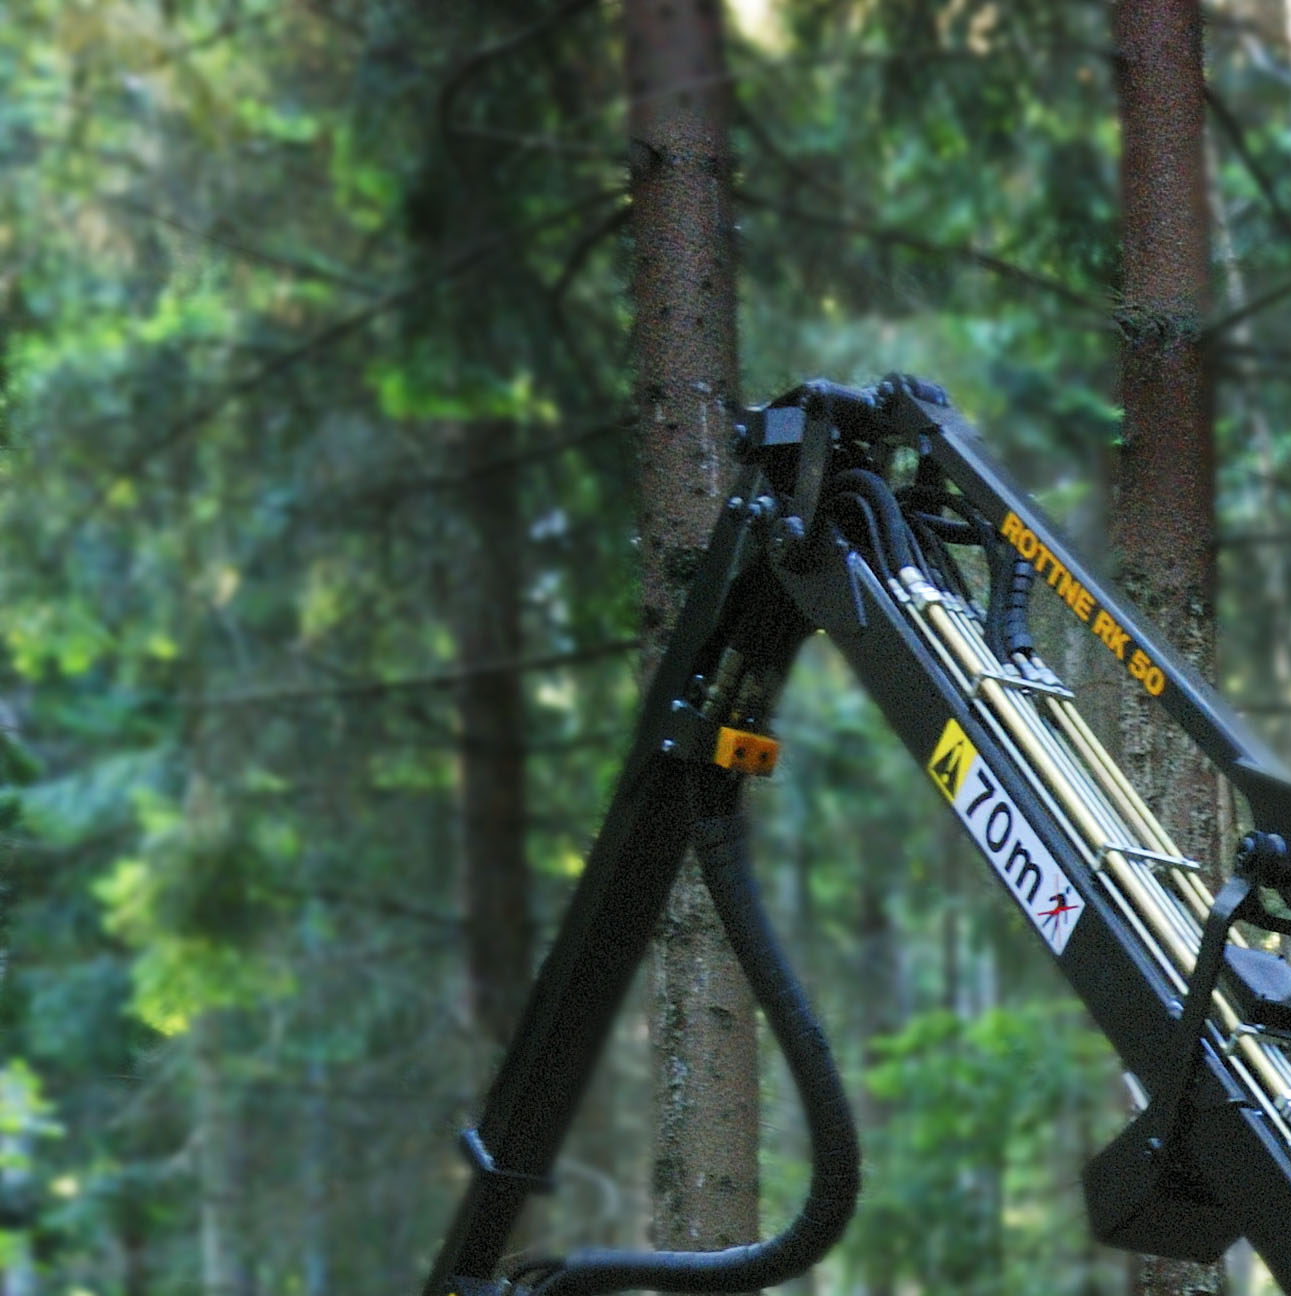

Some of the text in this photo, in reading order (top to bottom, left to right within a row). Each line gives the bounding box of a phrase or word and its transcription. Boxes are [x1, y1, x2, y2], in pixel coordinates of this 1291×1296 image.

[1001, 511, 1165, 696] ROTTNE RK 50
[966, 768, 1041, 905] 70m
